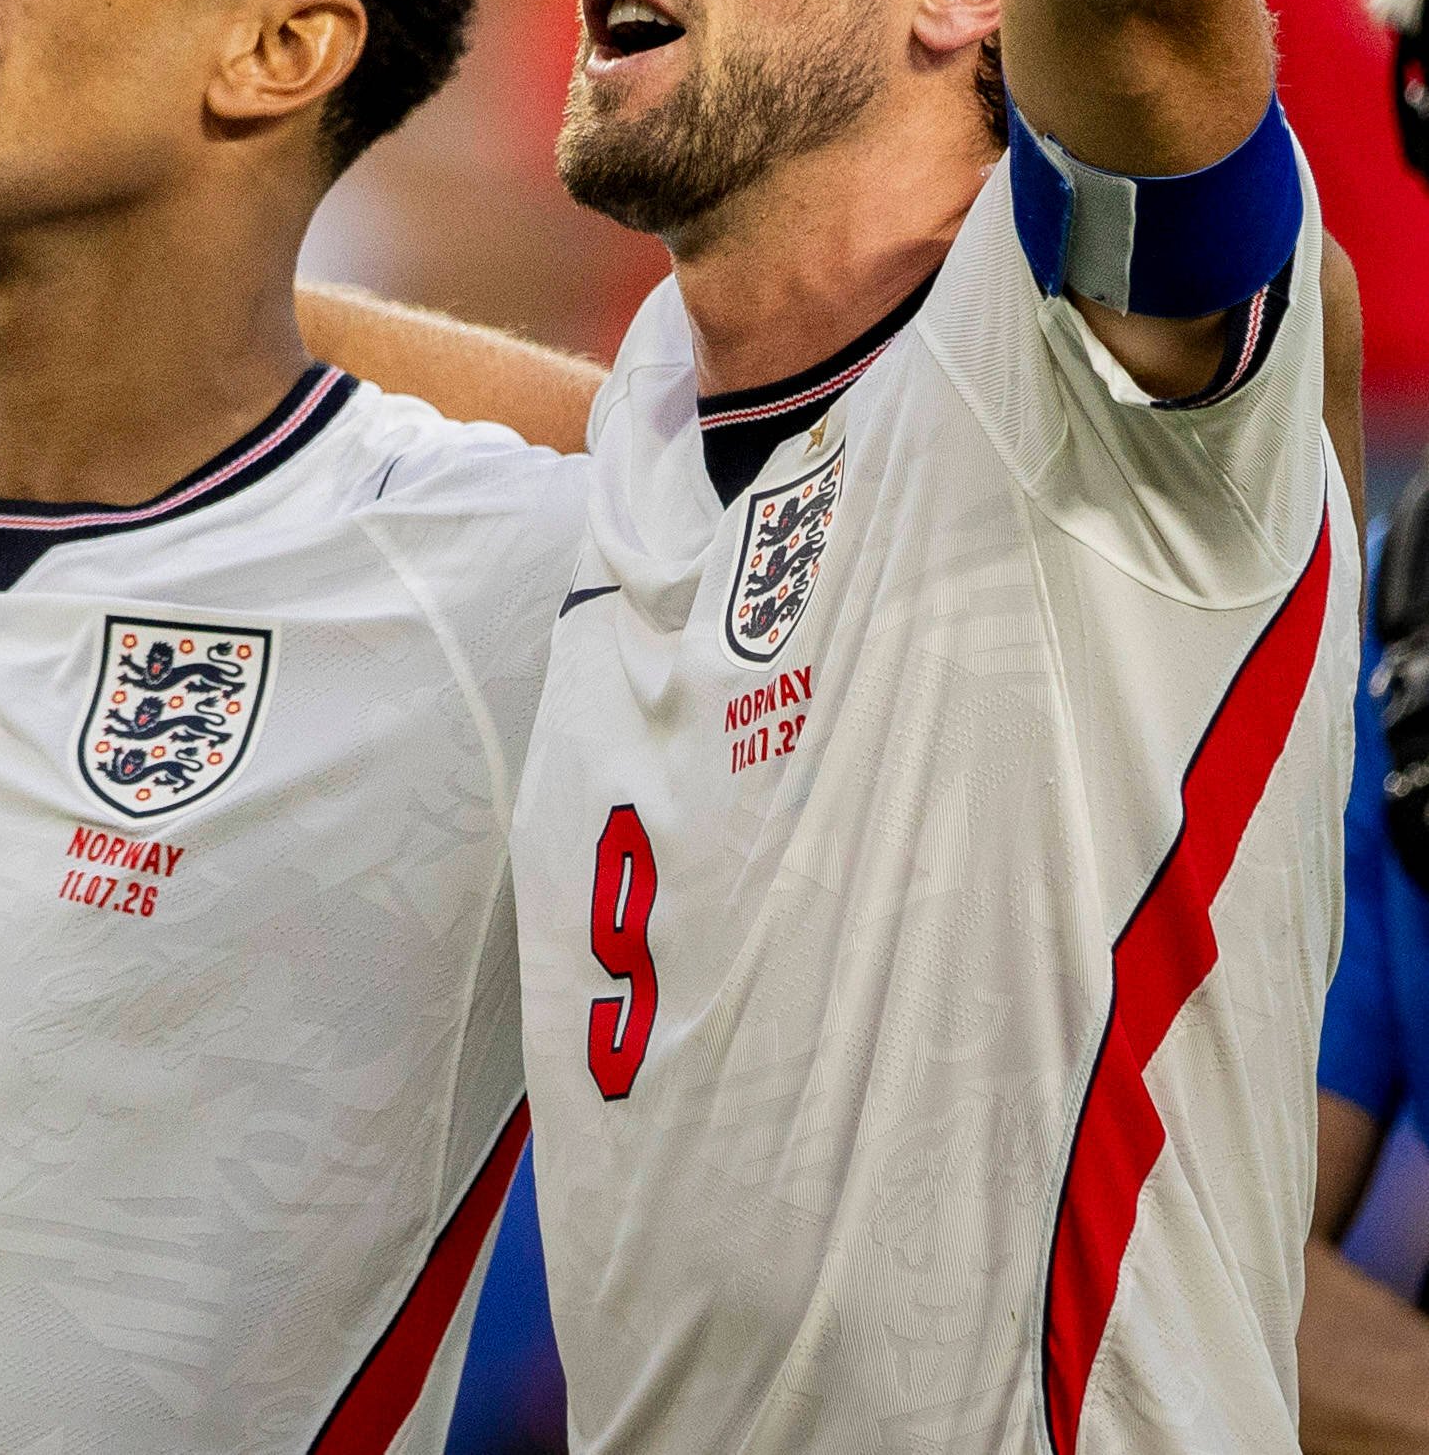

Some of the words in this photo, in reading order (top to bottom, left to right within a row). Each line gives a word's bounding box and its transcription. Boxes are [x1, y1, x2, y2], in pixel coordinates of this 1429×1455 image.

[725, 665, 812, 733] NORWAY
[66, 826, 184, 877] NORWAY
[58, 870, 158, 917] 11.07.26
[588, 803, 658, 1102] 9
